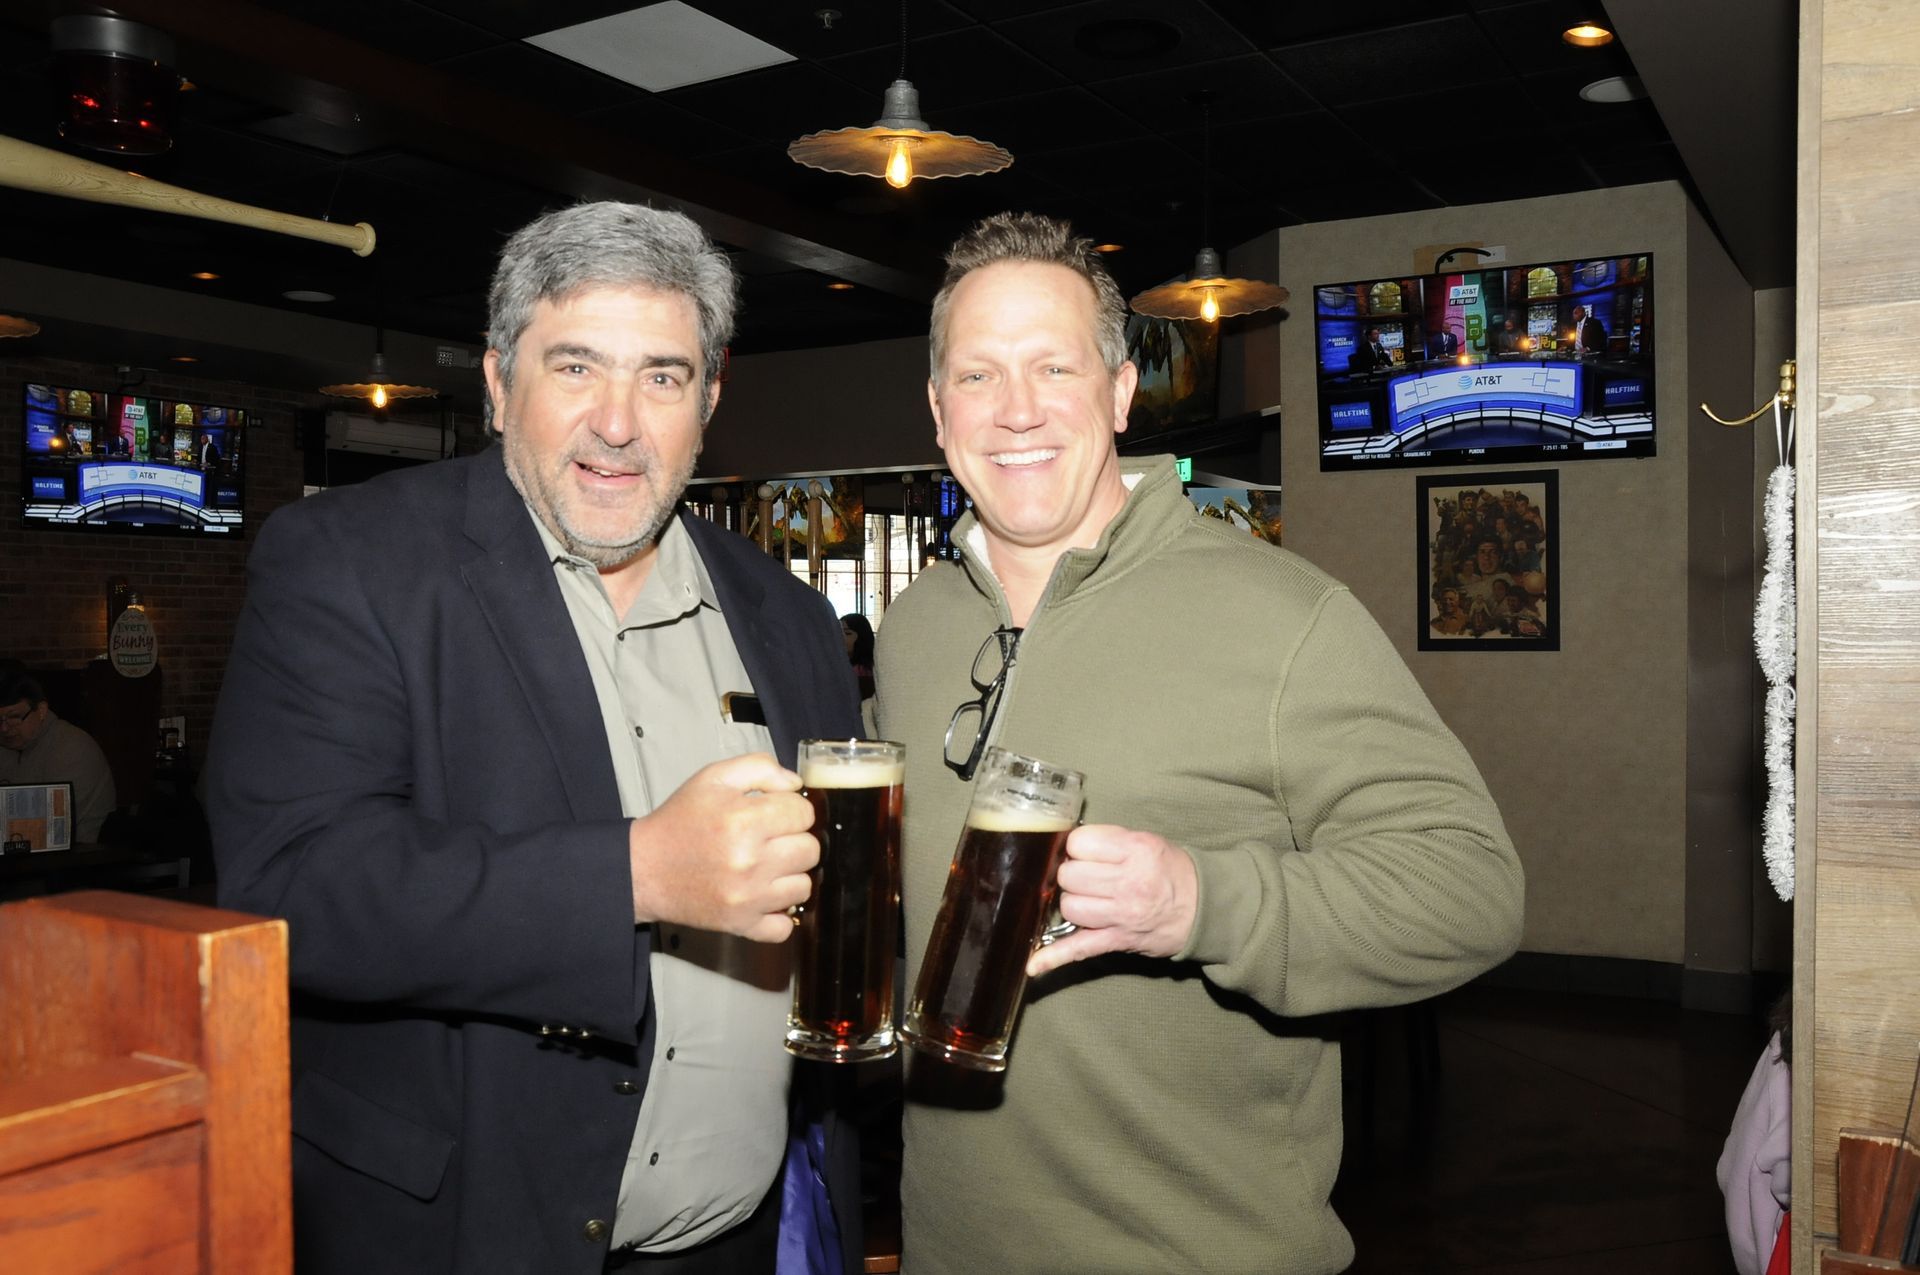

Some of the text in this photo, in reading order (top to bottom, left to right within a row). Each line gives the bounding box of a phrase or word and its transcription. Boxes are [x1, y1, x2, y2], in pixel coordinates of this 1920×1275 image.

[1461, 288, 1477, 296] AT&T
[1474, 374, 1503, 387] AT&T
[1605, 384, 1641, 396] HALFTIME
[1333, 407, 1369, 419] HALFTIME
[138, 471, 157, 480] AT&T
[117, 623, 148, 634] Every
[113, 635, 153, 651] Bunny
